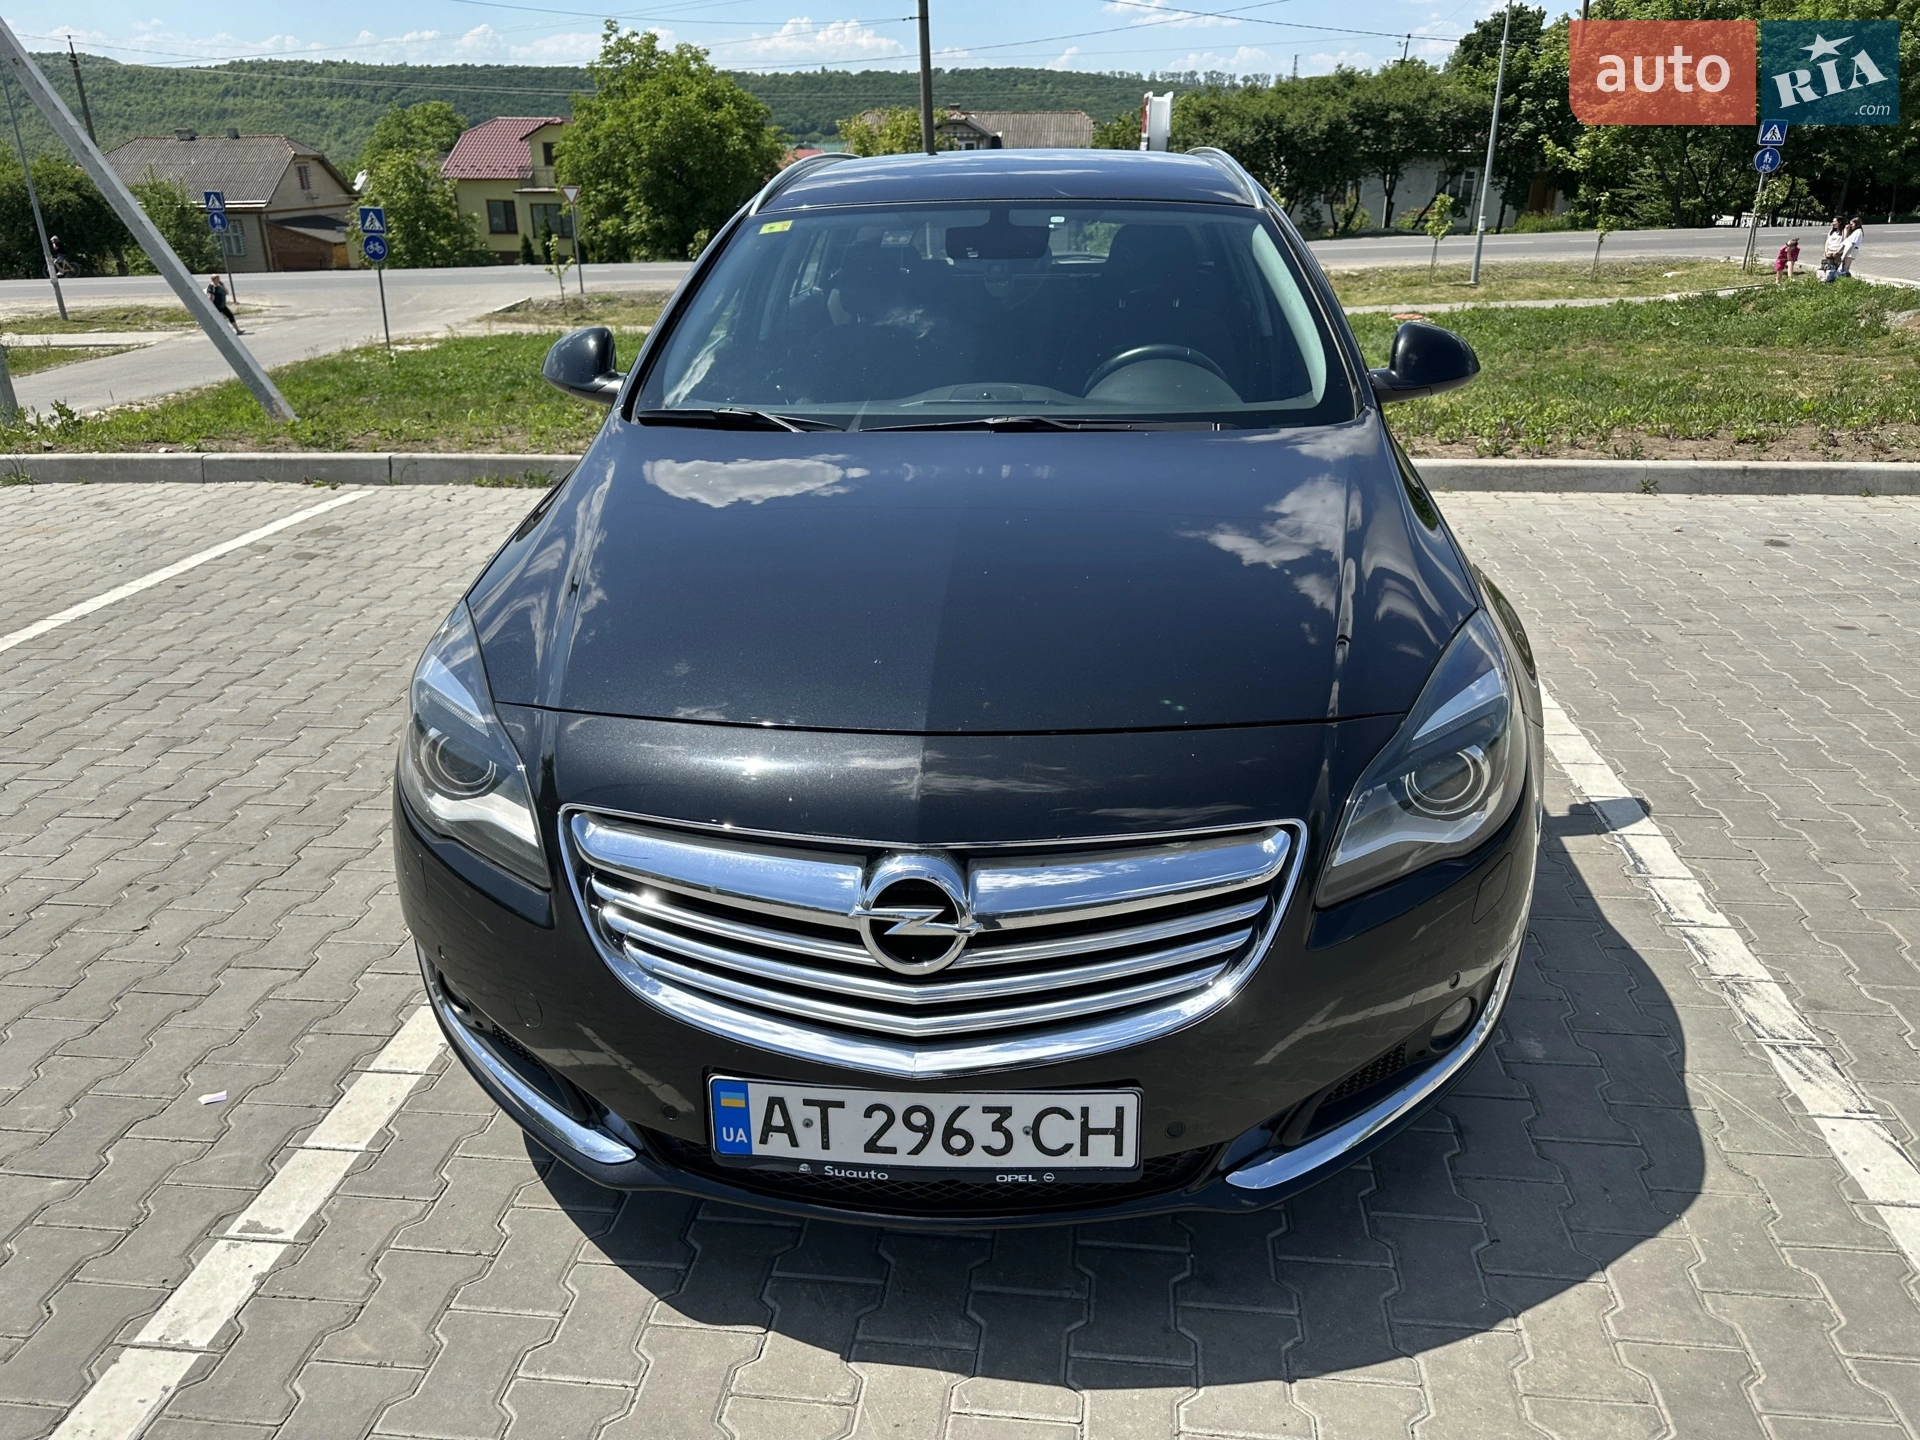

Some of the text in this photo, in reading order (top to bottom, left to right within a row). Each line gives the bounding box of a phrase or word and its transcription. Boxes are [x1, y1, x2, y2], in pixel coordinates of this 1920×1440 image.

[758, 1096, 1125, 1157] AT 2963 CH
[722, 1127, 748, 1143] UA
[824, 1165, 889, 1181] Suauto
[996, 1174, 1037, 1183] OPEL
